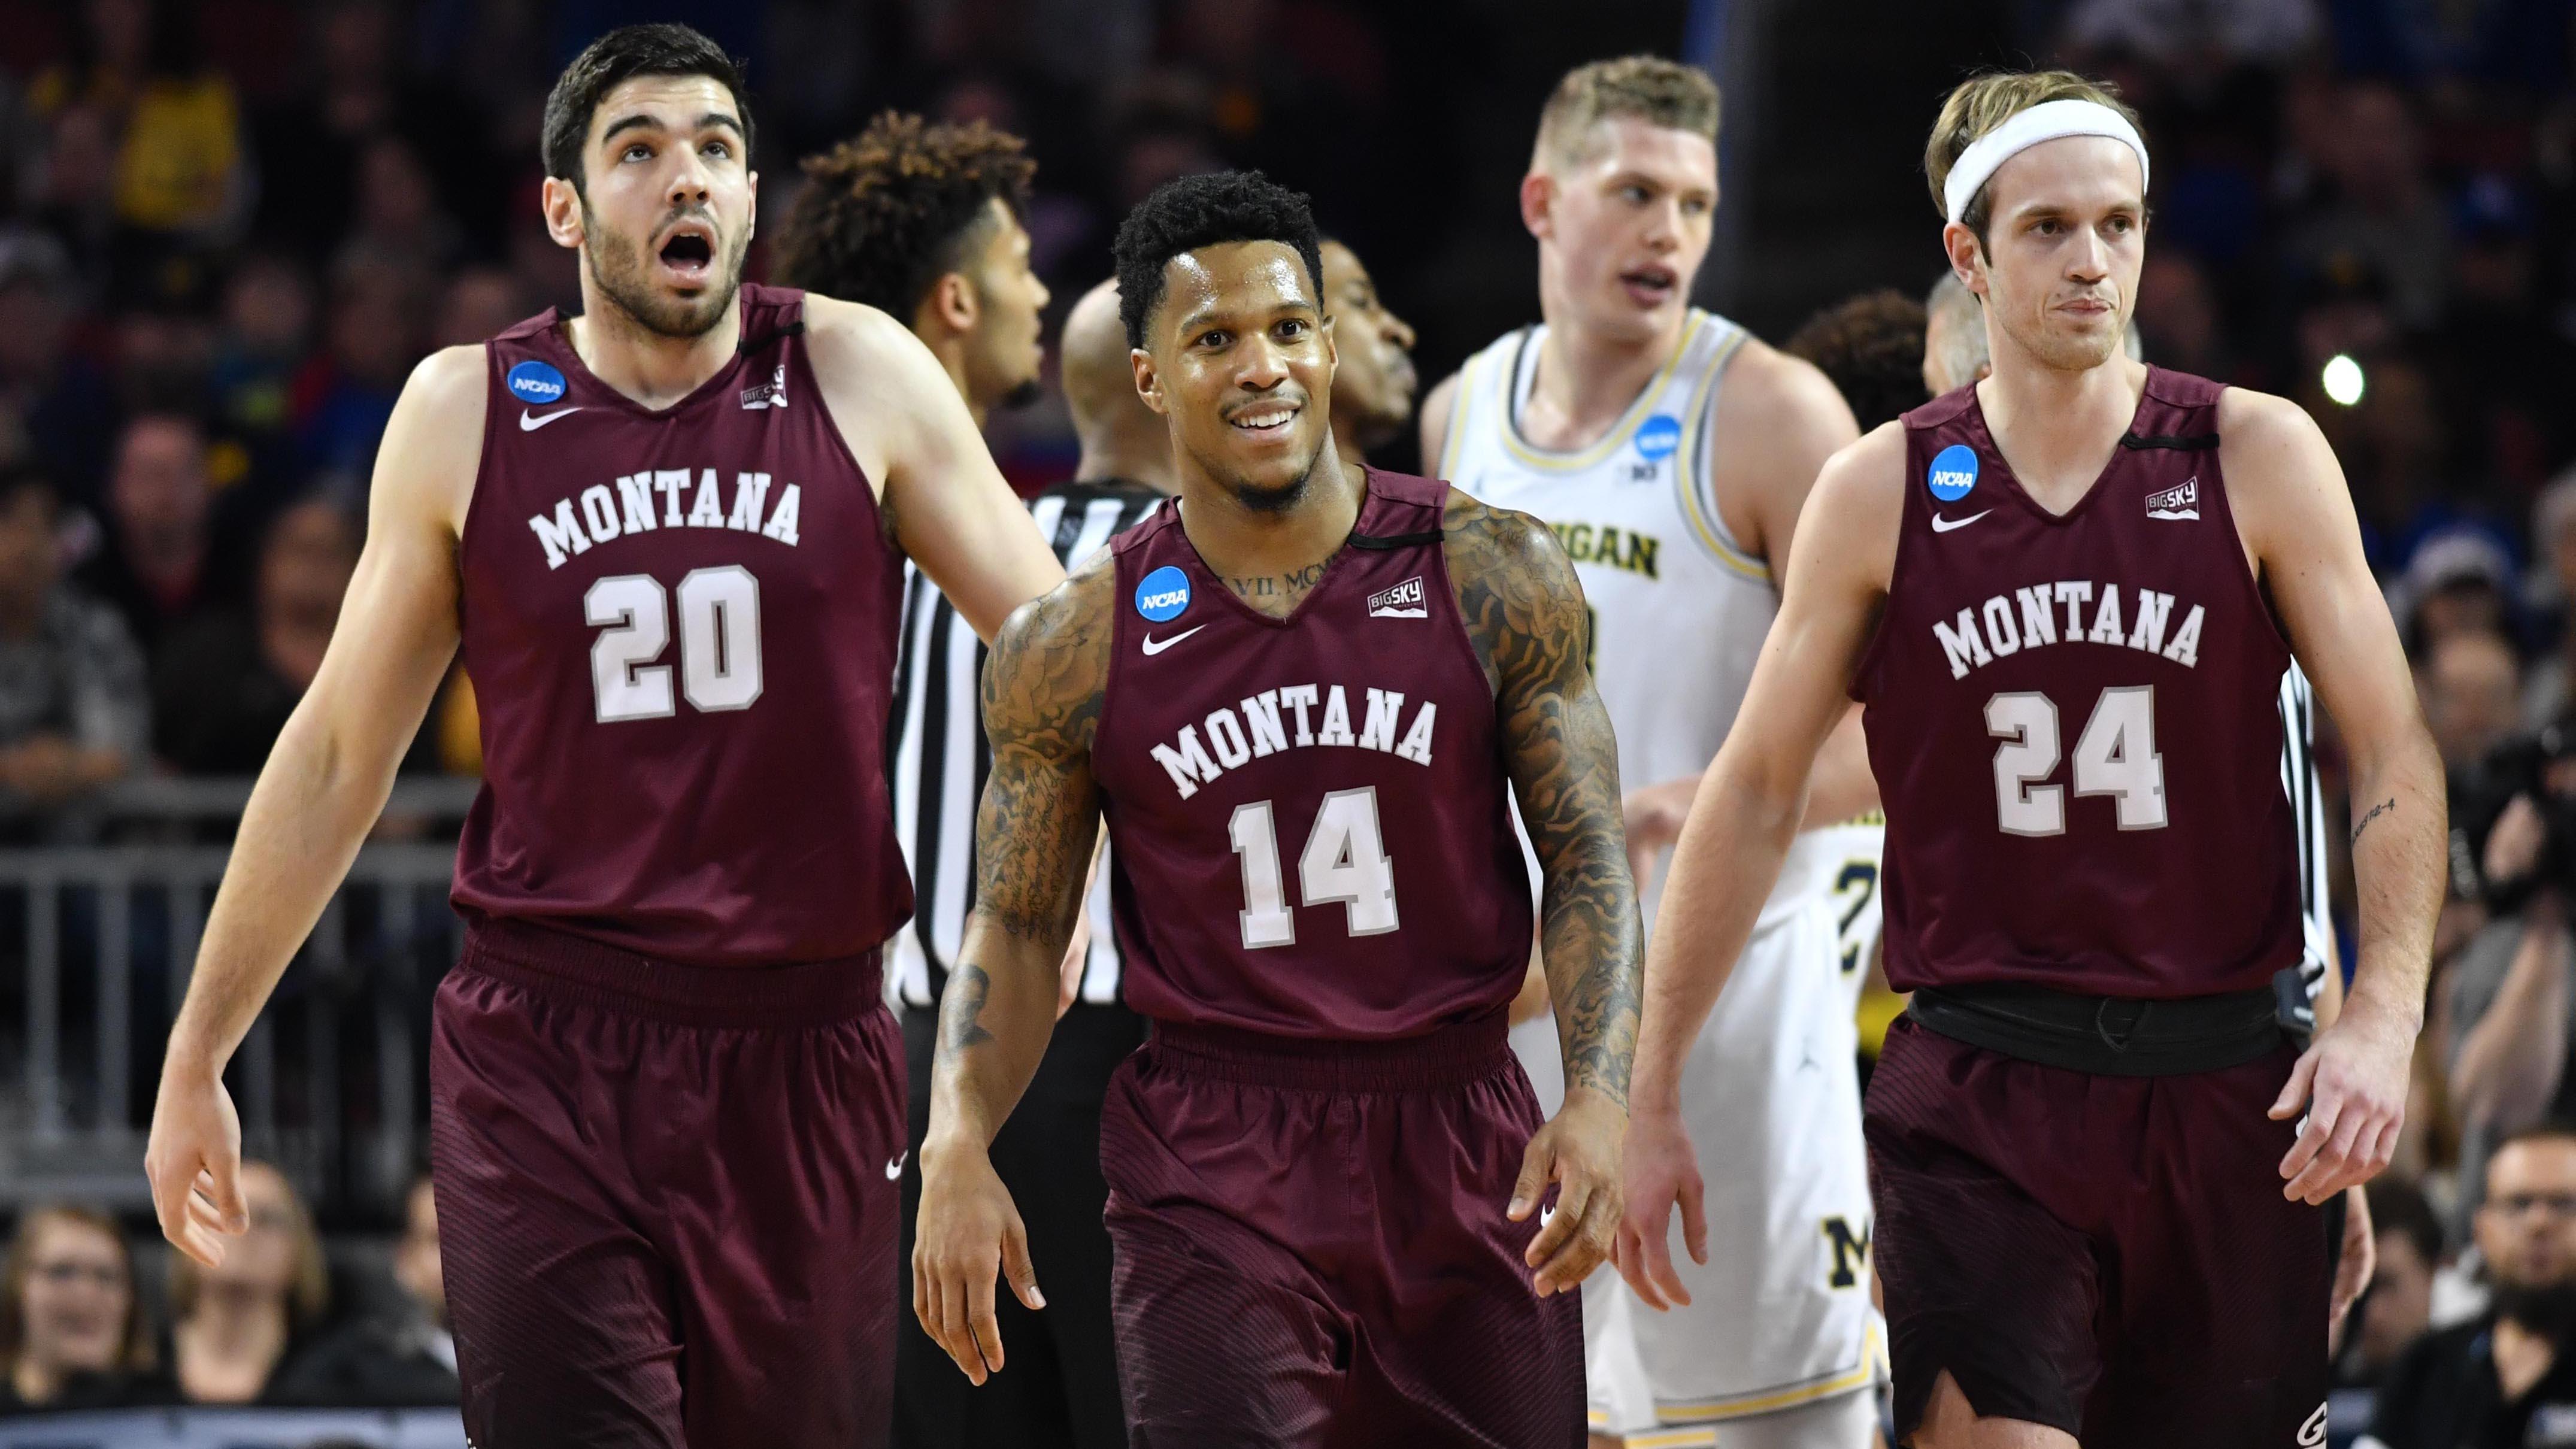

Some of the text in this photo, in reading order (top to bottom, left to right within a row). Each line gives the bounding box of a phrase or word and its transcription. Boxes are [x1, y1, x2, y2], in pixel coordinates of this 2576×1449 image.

[514, 378, 561, 395] NCAA
[528, 468, 801, 571] MONTANA
[1932, 471, 1974, 489] NCAA
[584, 565, 763, 724] 20
[1142, 589, 1187, 610] NCAA
[1932, 580, 2205, 681] MONTANA
[1150, 683, 1437, 801] MONTANA
[1983, 684, 2168, 838] 24
[1228, 786, 1399, 949] 14
